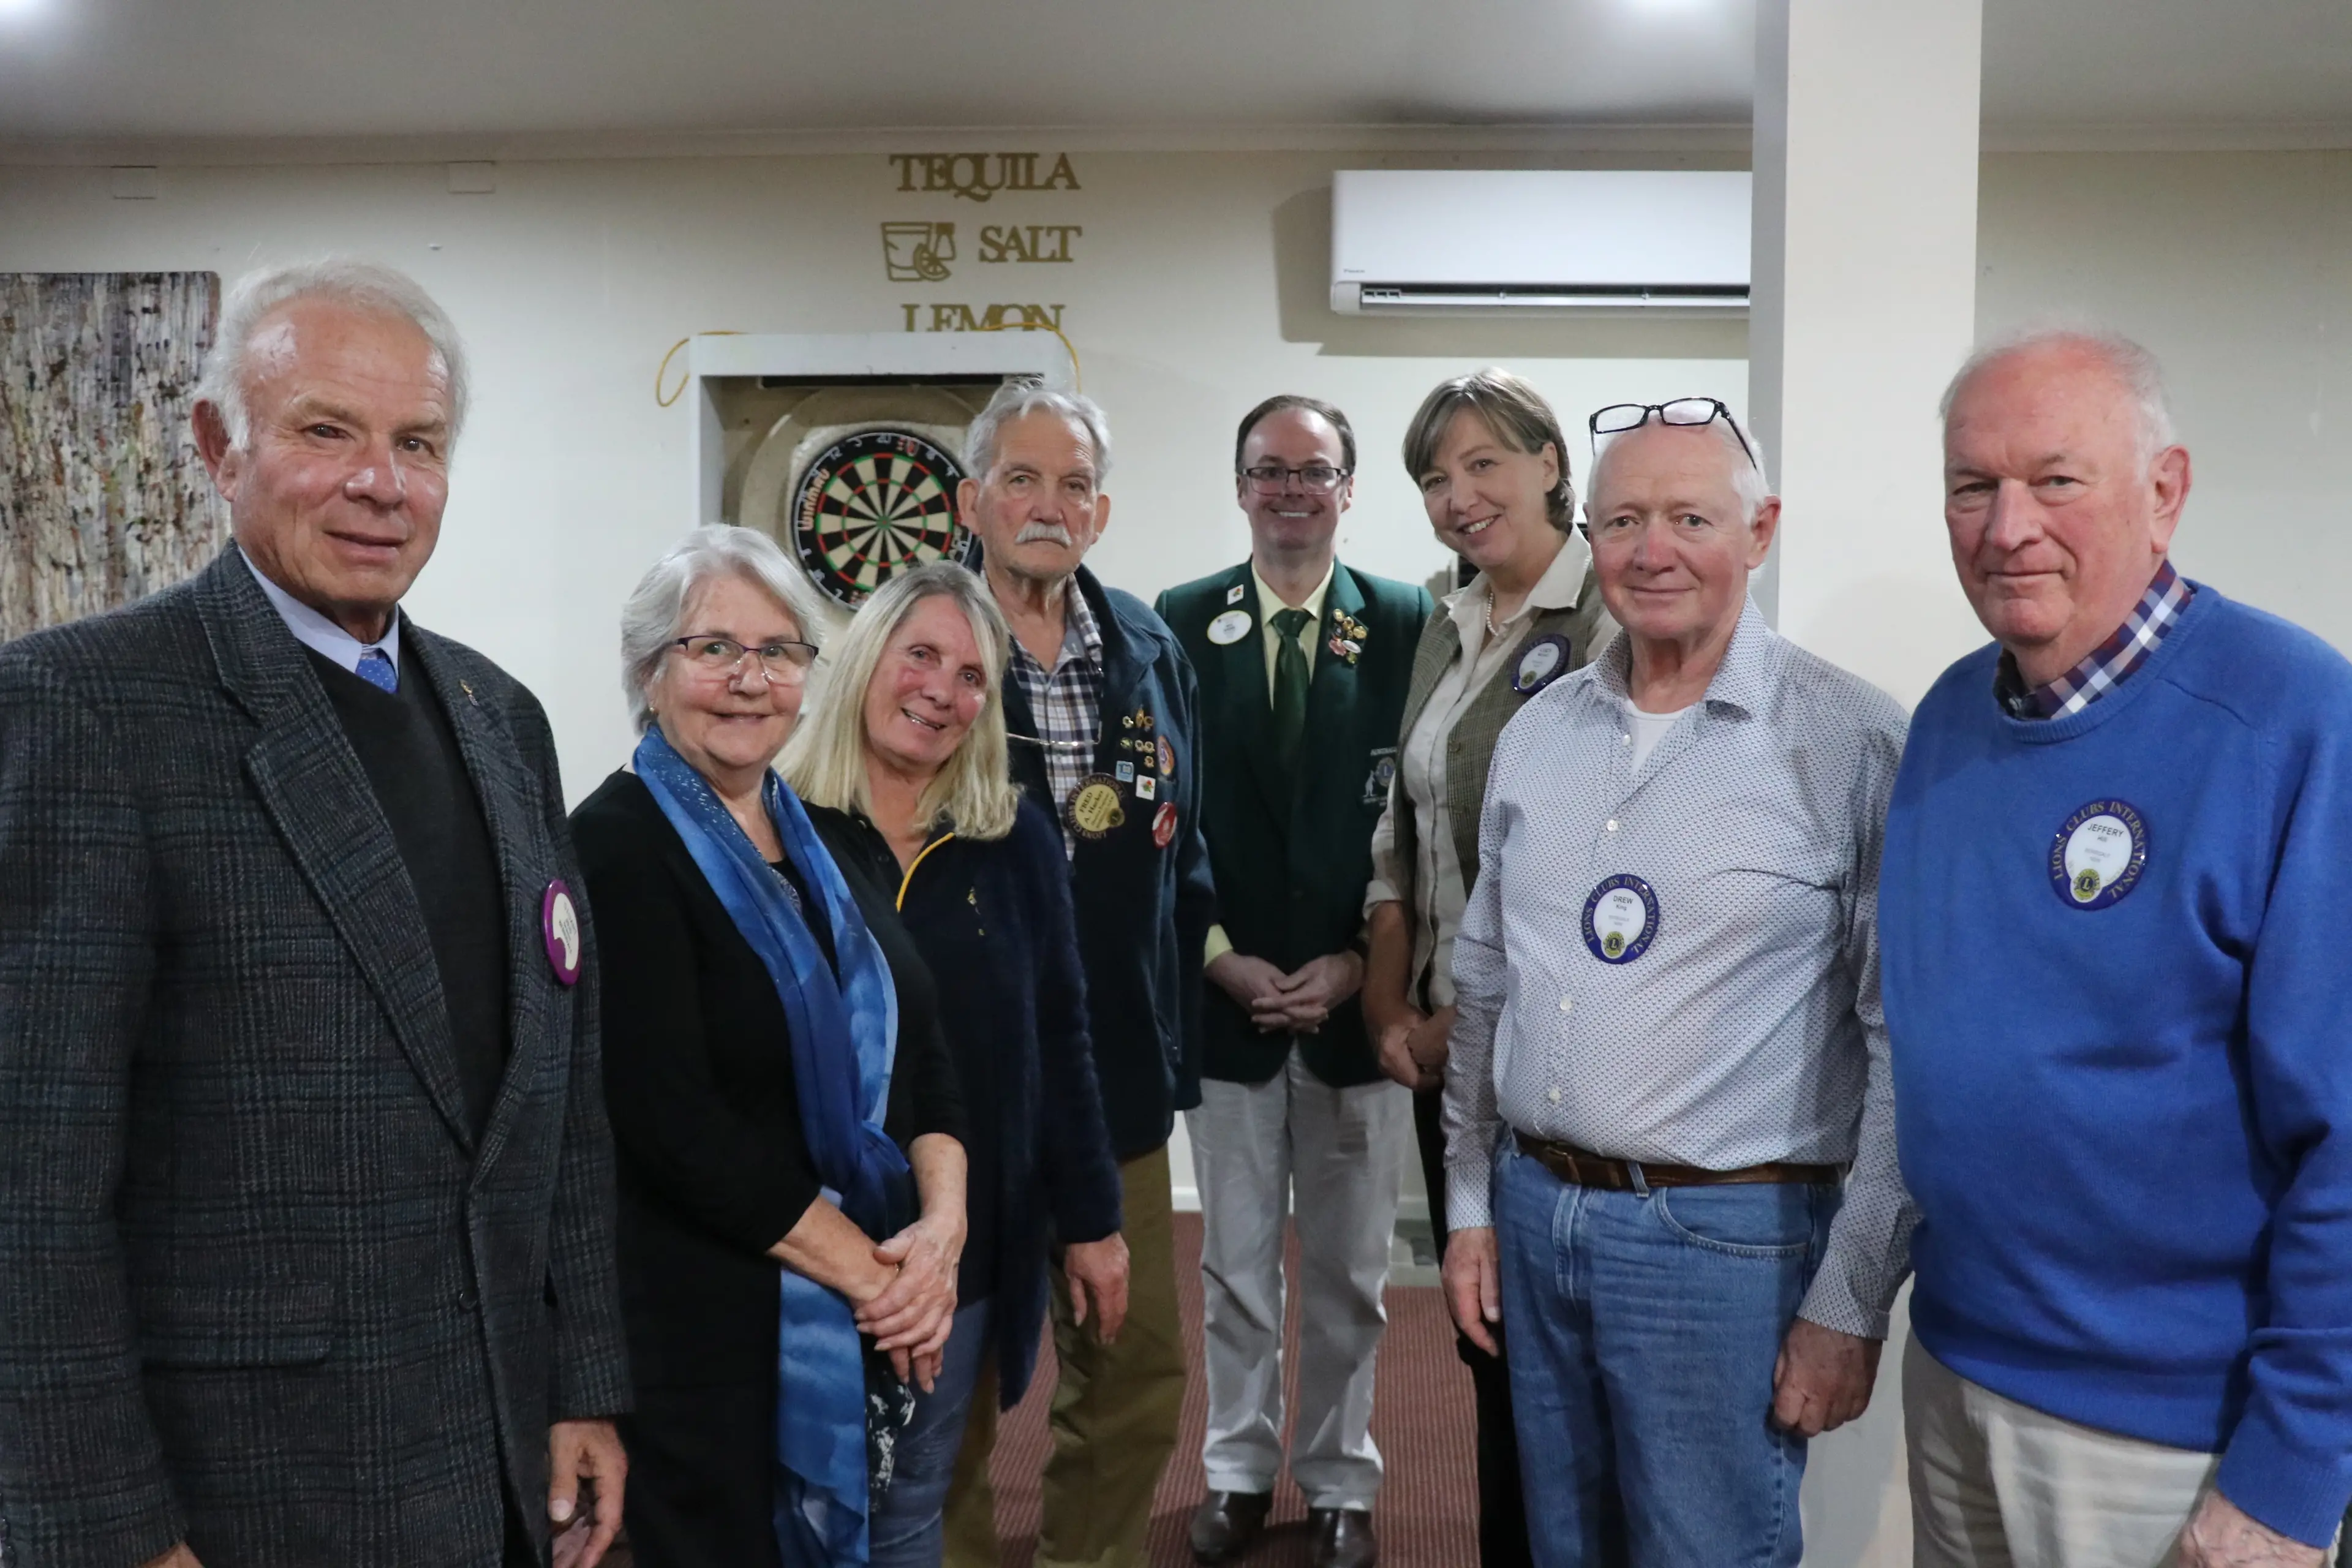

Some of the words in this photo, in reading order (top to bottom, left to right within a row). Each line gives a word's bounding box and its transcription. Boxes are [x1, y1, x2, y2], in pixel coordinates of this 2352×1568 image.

[889, 152, 1082, 202] TEQUILA
[978, 225, 1082, 263] SALT
[1079, 792, 1093, 813] FRED
[2087, 823, 2124, 838] JEFFERY
[2052, 835, 2067, 881] LIONS
[2066, 801, 2105, 832] CLUBS
[2107, 801, 2146, 899] INTERNATIONAL
[1584, 907, 1594, 943] LIONS
[1591, 877, 1620, 903] CLUBS
[1624, 876, 1656, 954] INTERNATIONAL
[1613, 895, 1634, 905] DREW
